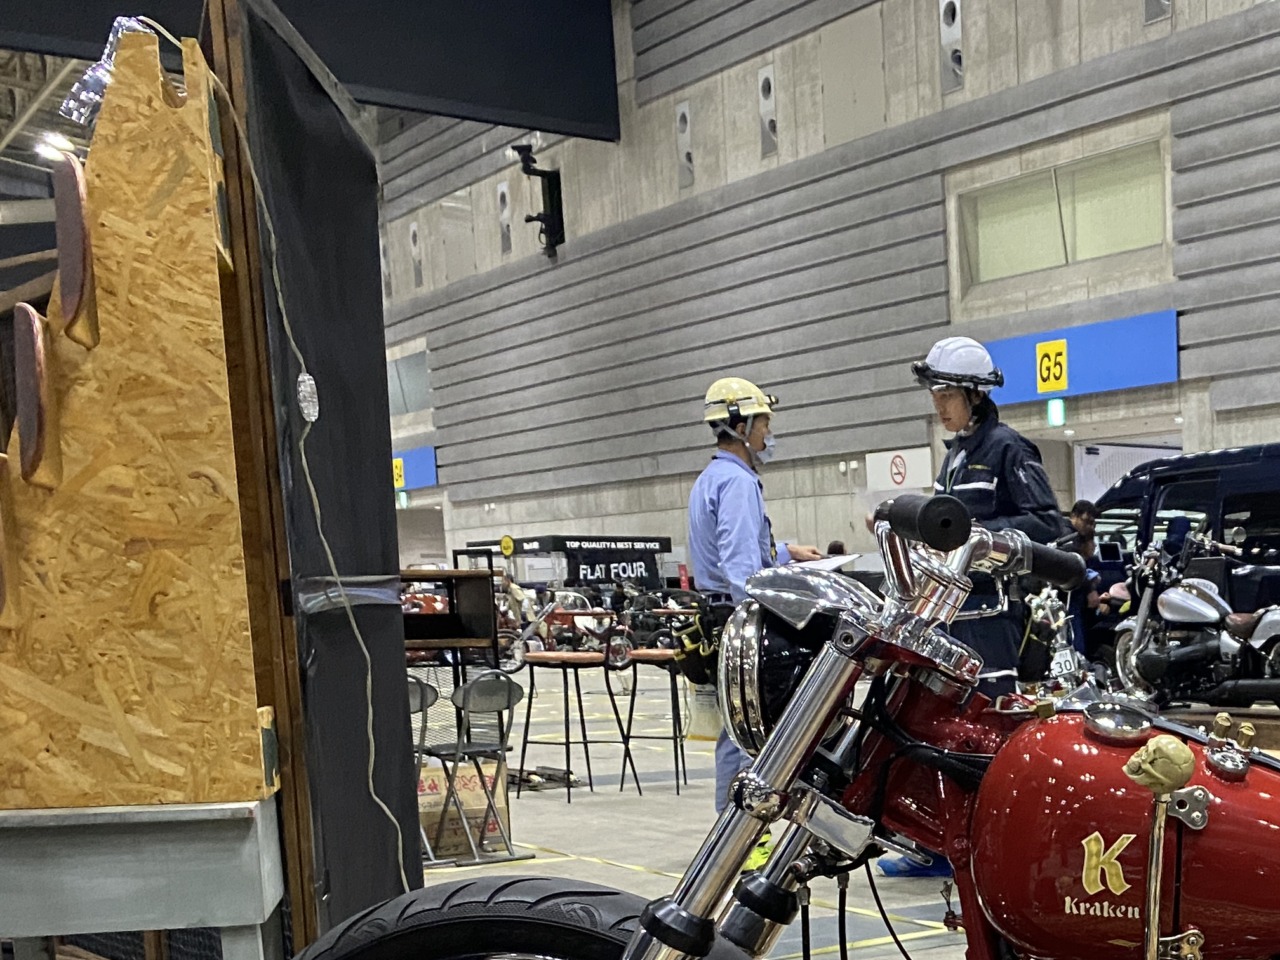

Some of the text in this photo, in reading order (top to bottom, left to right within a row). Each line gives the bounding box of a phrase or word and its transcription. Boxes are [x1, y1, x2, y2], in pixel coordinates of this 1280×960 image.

[1039, 351, 1064, 383] G5
[565, 541, 580, 549] TOP
[633, 542, 660, 550] SERVICE
[579, 561, 646, 580] FLAT FOUR
[1055, 659, 1073, 674] 30
[1081, 831, 1137, 896] K
[1064, 896, 1140, 919] Kraken
